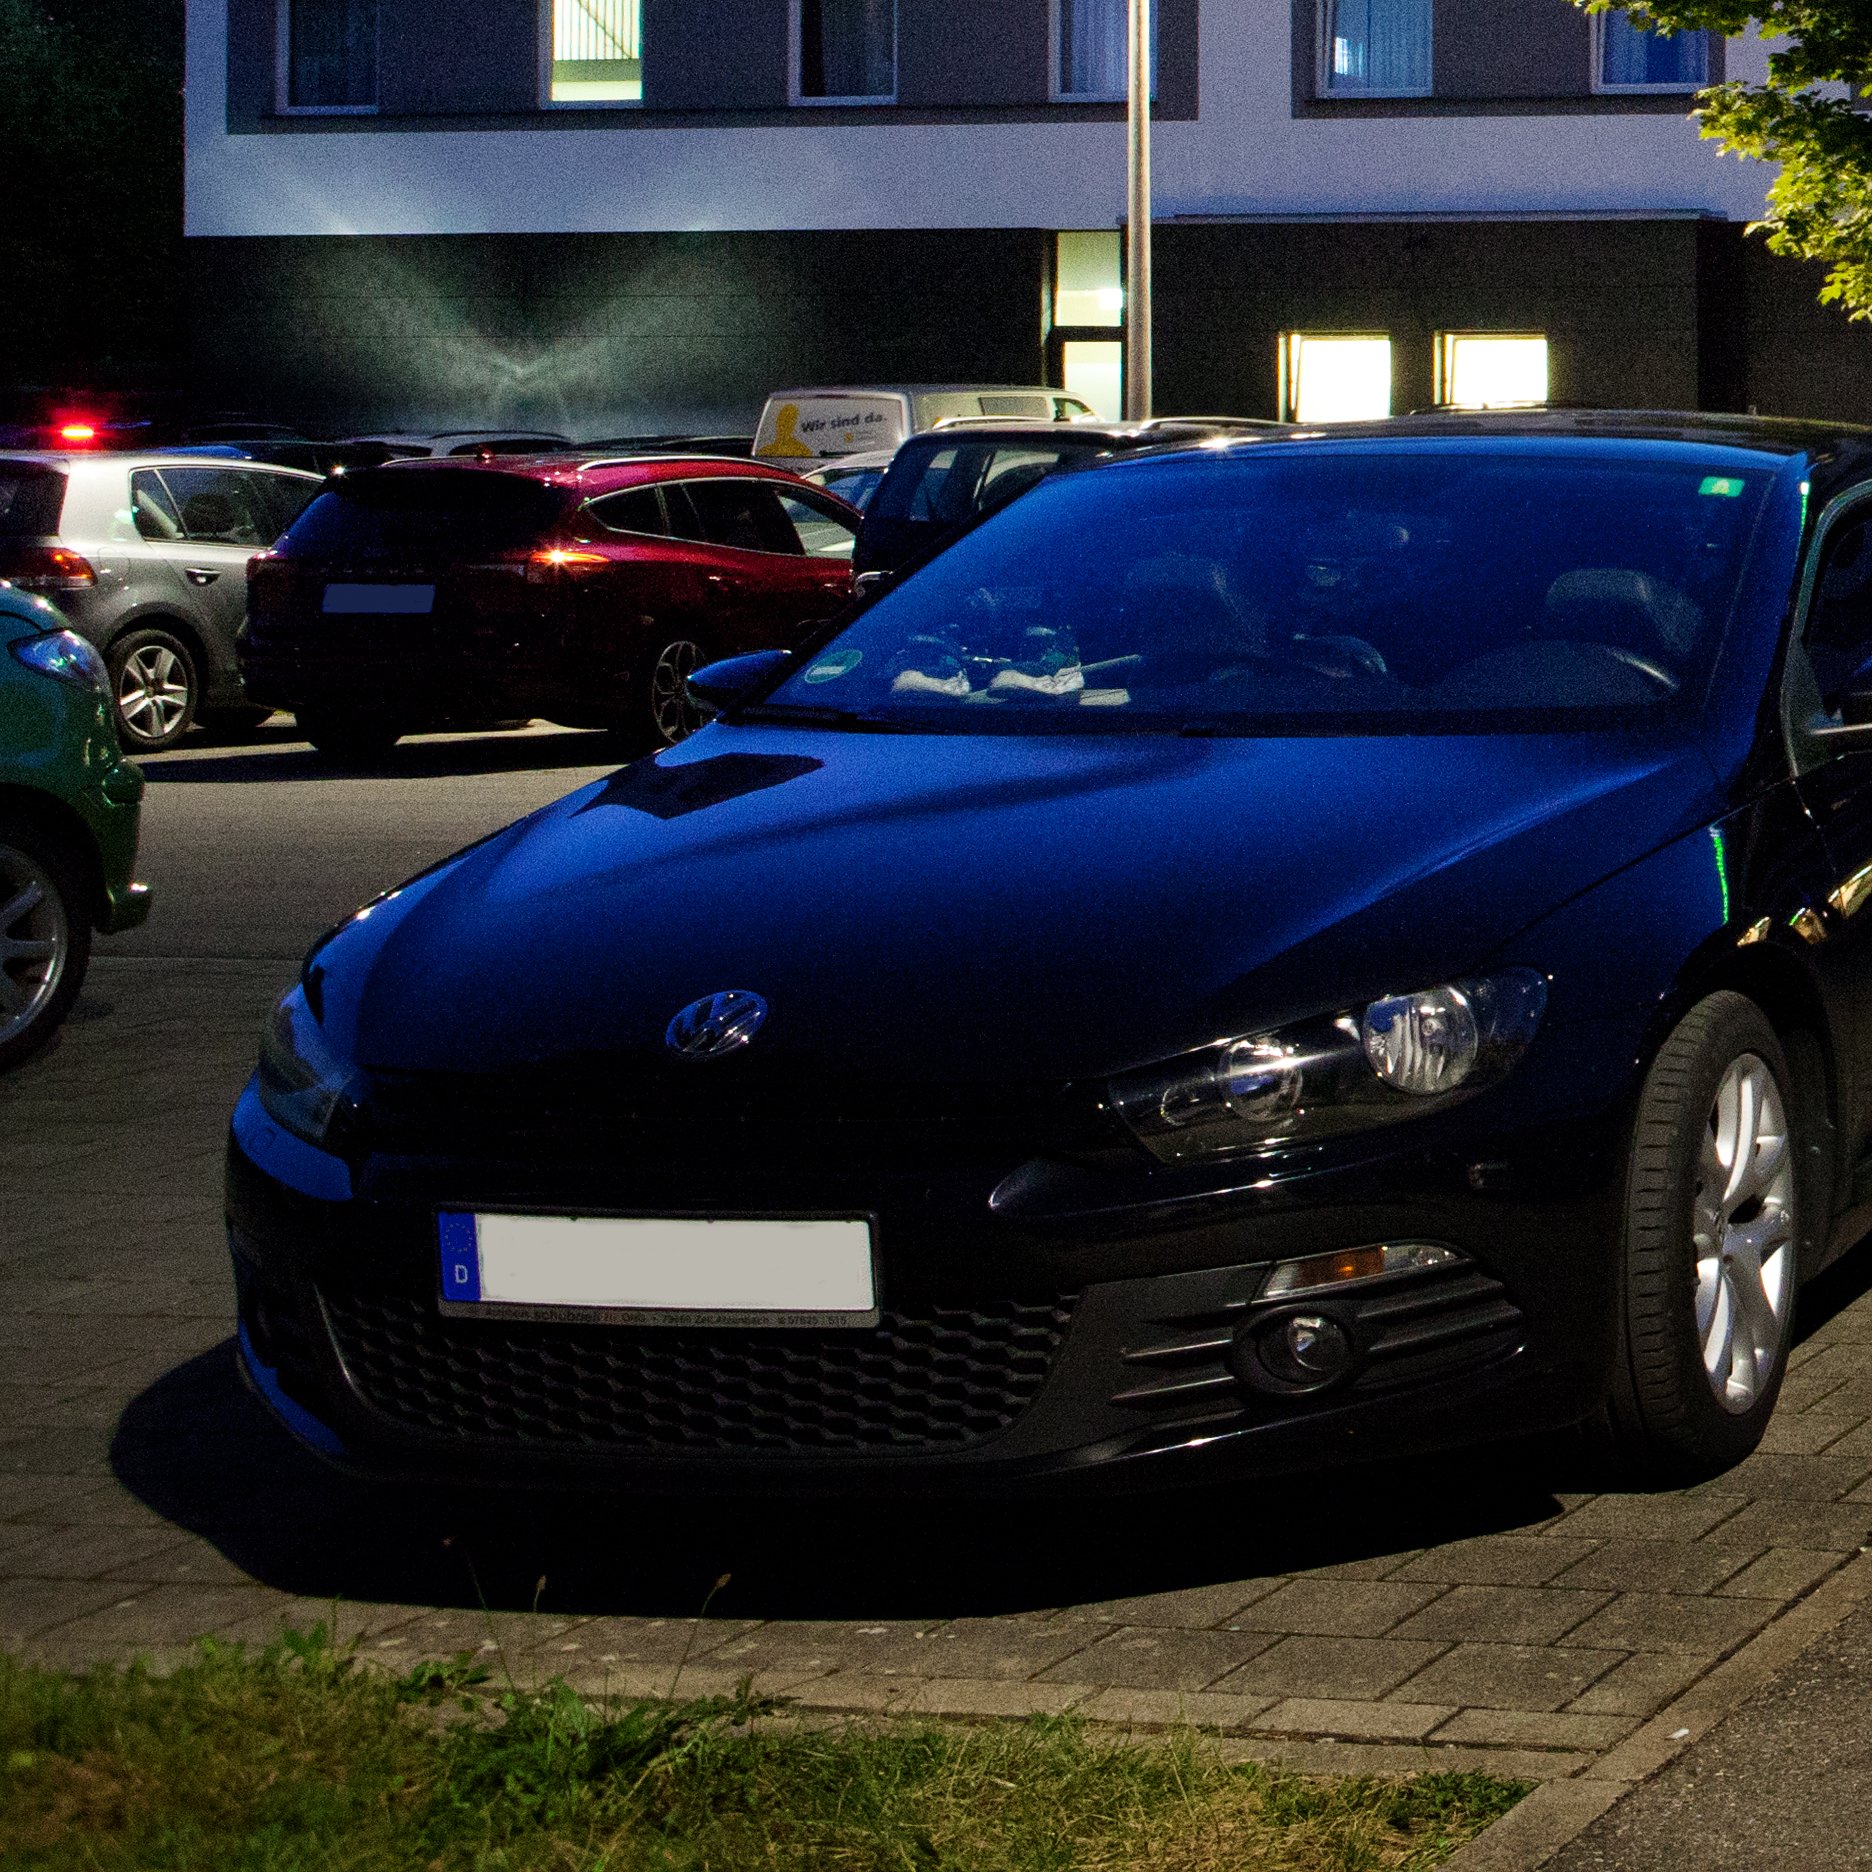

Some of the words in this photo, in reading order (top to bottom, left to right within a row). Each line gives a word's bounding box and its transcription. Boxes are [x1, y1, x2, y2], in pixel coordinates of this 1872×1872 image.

[801, 419, 826, 432] Wir
[831, 413, 860, 428] sind
[864, 411, 888, 424] da.
[453, 1263, 470, 1285] D
